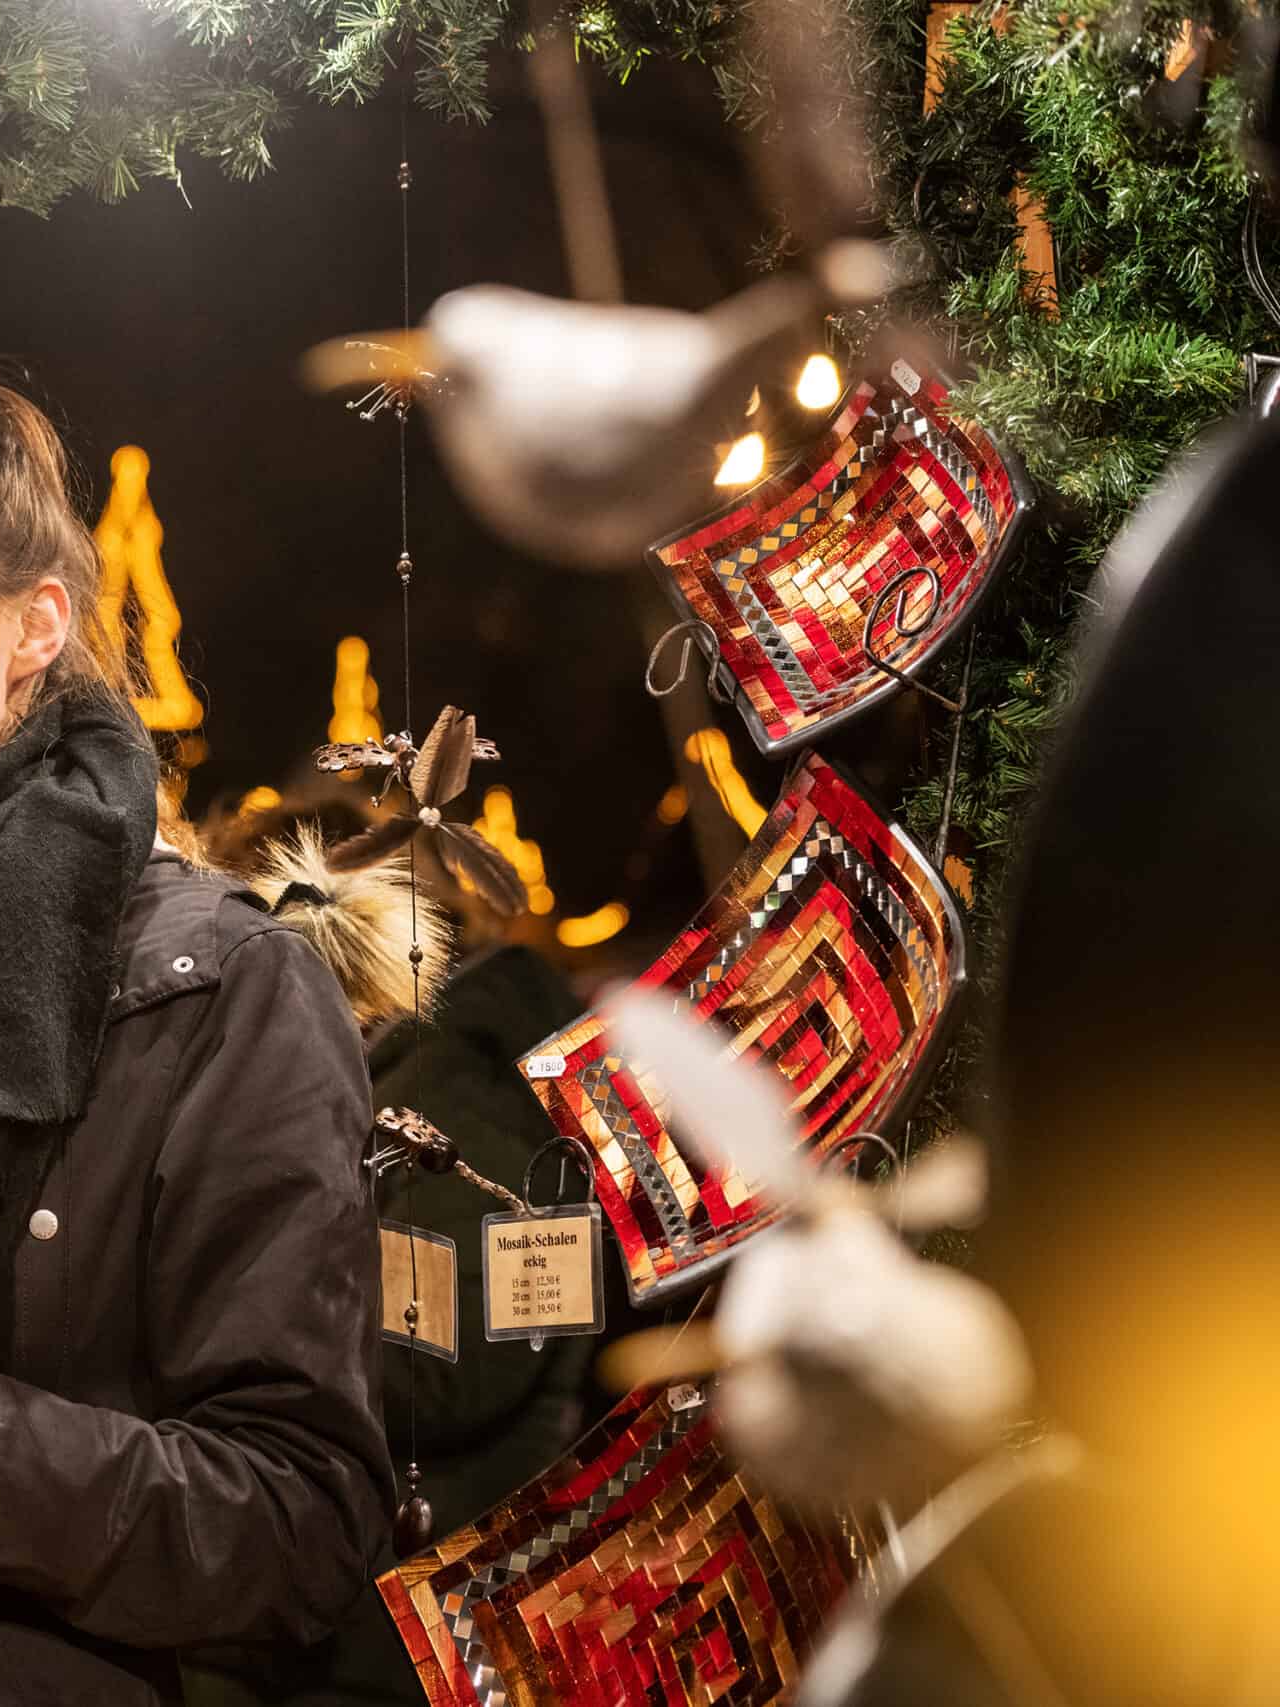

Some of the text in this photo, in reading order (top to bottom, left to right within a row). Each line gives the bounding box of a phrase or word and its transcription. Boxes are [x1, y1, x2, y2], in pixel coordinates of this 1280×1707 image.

[497, 1231, 577, 1252] Mosaik-Schalen
[523, 1255, 547, 1269] eckig
[537, 1303, 555, 1314] 19,50
